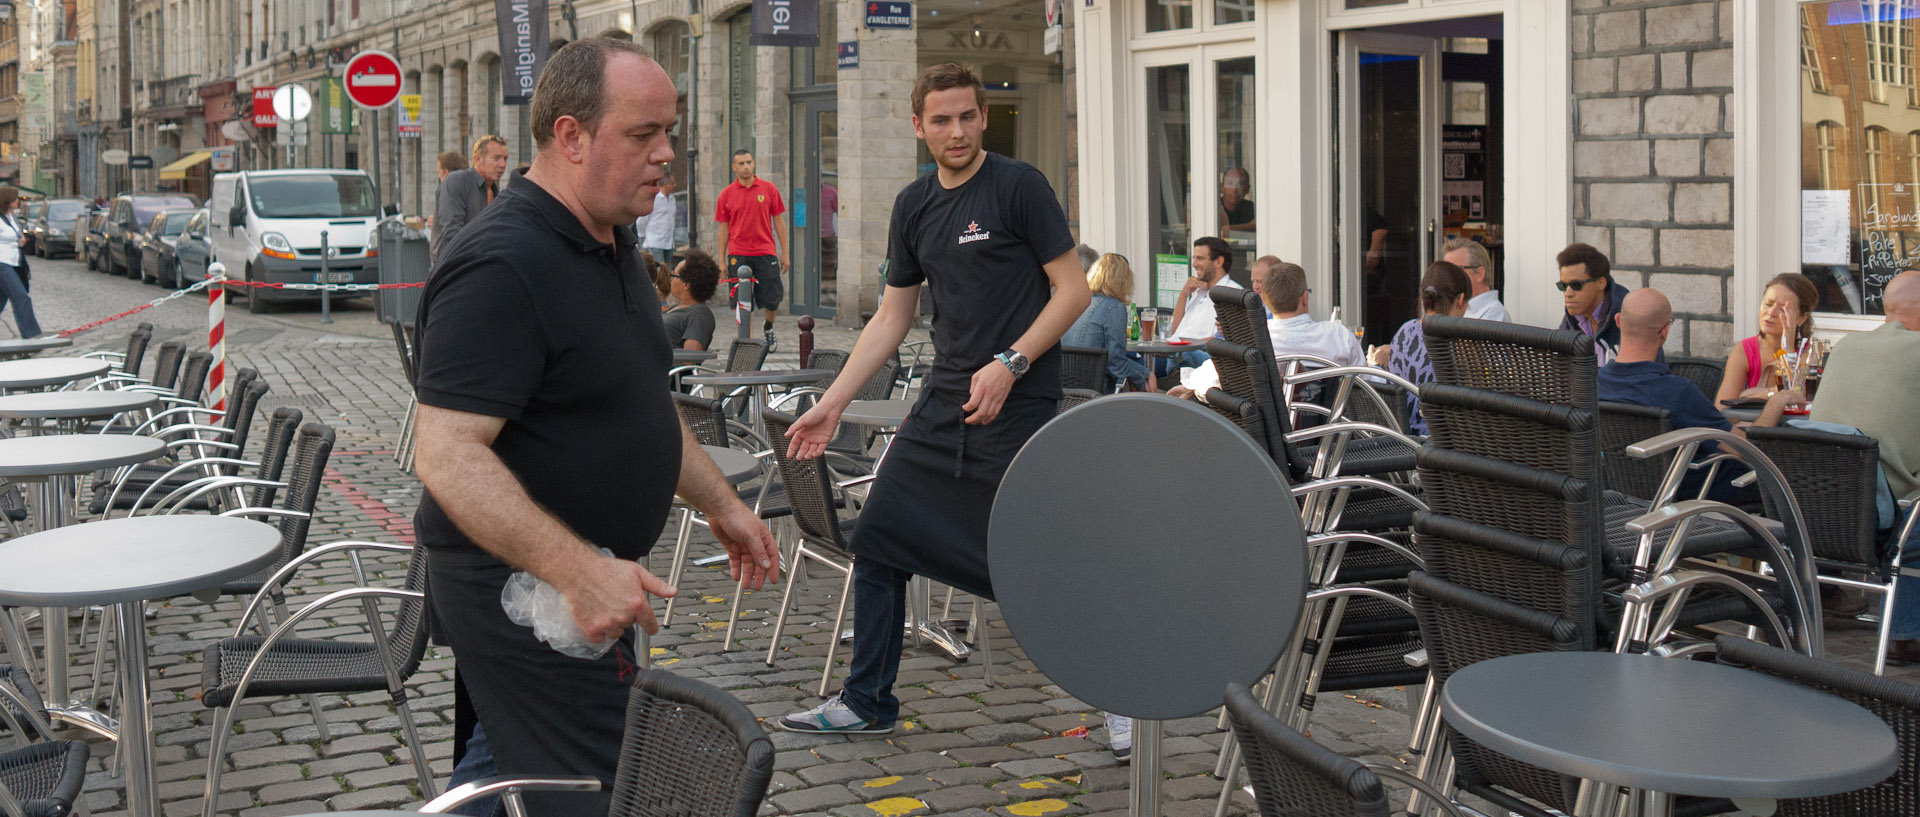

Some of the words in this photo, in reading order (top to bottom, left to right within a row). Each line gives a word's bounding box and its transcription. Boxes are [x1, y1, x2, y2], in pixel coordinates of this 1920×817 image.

[890, 5, 902, 14] Rue
[867, 16, 910, 25] d'ANGLETERRE
[958, 232, 990, 245] Heineken
